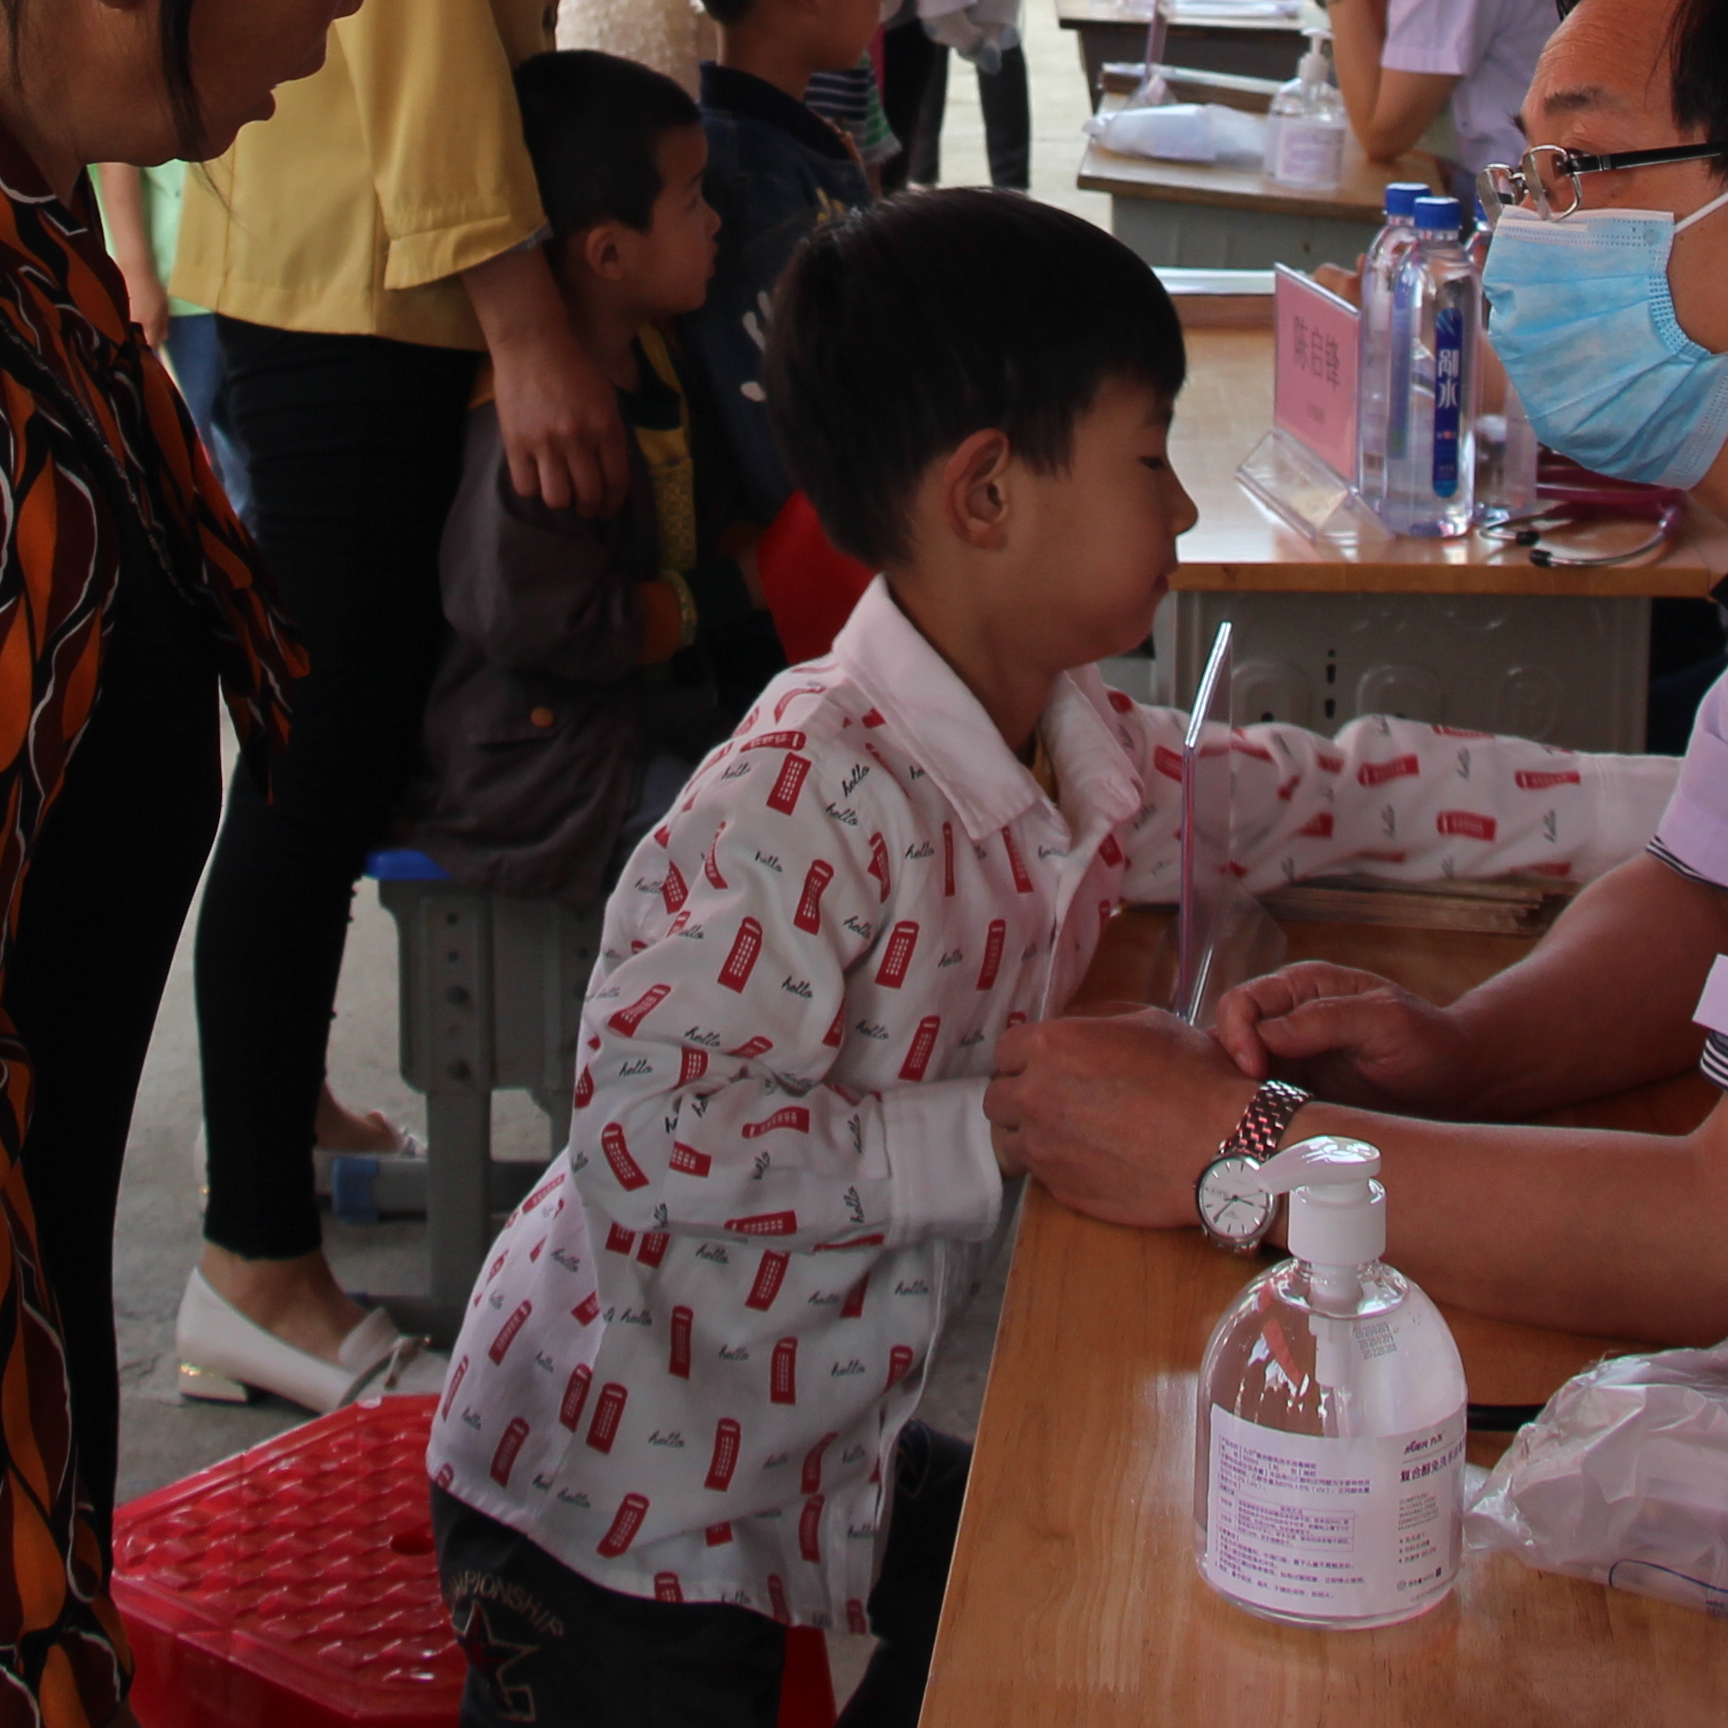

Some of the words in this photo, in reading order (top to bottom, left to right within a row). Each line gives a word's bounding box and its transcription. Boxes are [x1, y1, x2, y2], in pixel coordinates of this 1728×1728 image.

[841, 764, 870, 797] hello
[825, 802, 858, 826] hello
[904, 841, 935, 860] hello
[755, 851, 783, 872] hello
[781, 975, 813, 999] hello
[684, 1026, 721, 1048] hello
[855, 1019, 889, 1040] hello
[619, 1059, 653, 1077] hello
[844, 1186, 864, 1223] hello
[552, 1249, 580, 1272] hello
[695, 1243, 729, 1264] hello
[895, 1281, 928, 1295] hello
[621, 1308, 652, 1326] hello
[719, 1345, 749, 1360] hello
[831, 1360, 865, 1376] hello
[648, 1430, 684, 1448] hello
[557, 1490, 591, 1509] hello
